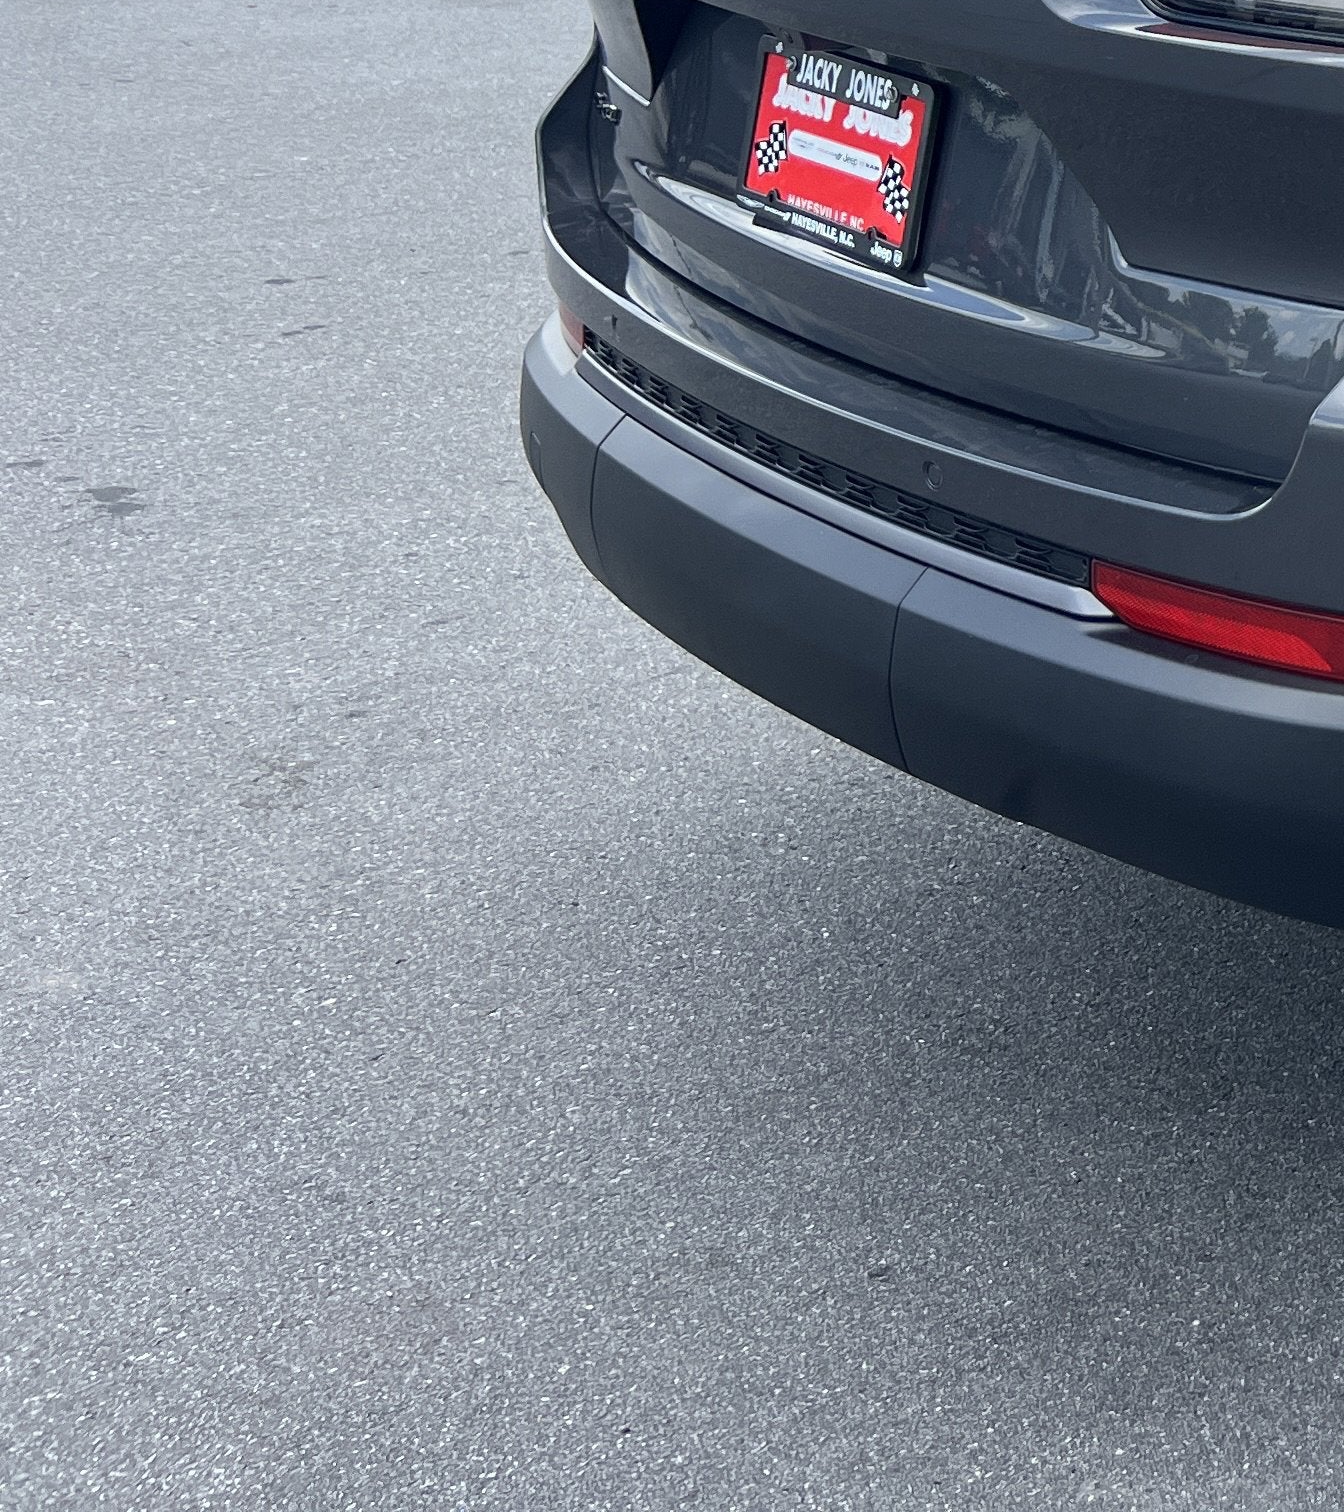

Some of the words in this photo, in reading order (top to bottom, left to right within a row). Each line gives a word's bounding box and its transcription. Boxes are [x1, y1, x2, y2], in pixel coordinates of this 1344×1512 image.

[796, 53, 843, 94] JACKY
[845, 68, 899, 111] JONES
[870, 240, 893, 264] Jeep
